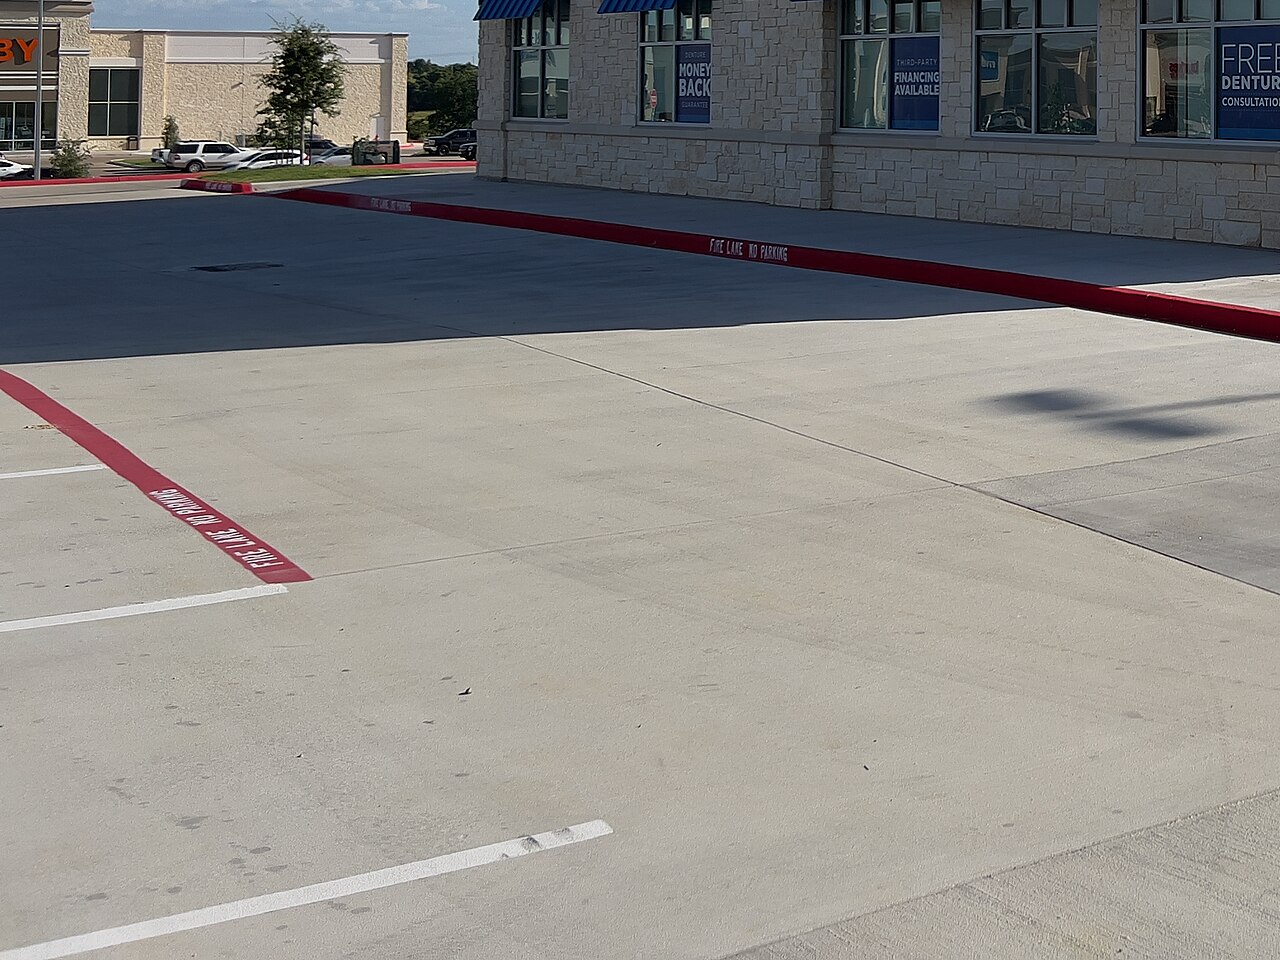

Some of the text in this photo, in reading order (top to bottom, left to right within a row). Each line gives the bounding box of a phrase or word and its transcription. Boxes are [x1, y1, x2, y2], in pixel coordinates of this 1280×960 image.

[896, 58, 938, 66] THIRD-PARTY
[679, 63, 711, 76] MONEY
[894, 71, 940, 83] FINANCING
[679, 78, 712, 97] BACK
[894, 84, 940, 96] AVAILABLE
[709, 238, 788, 262] FIRE LANE NO PARKING
[234, 548, 284, 569] FIRE
